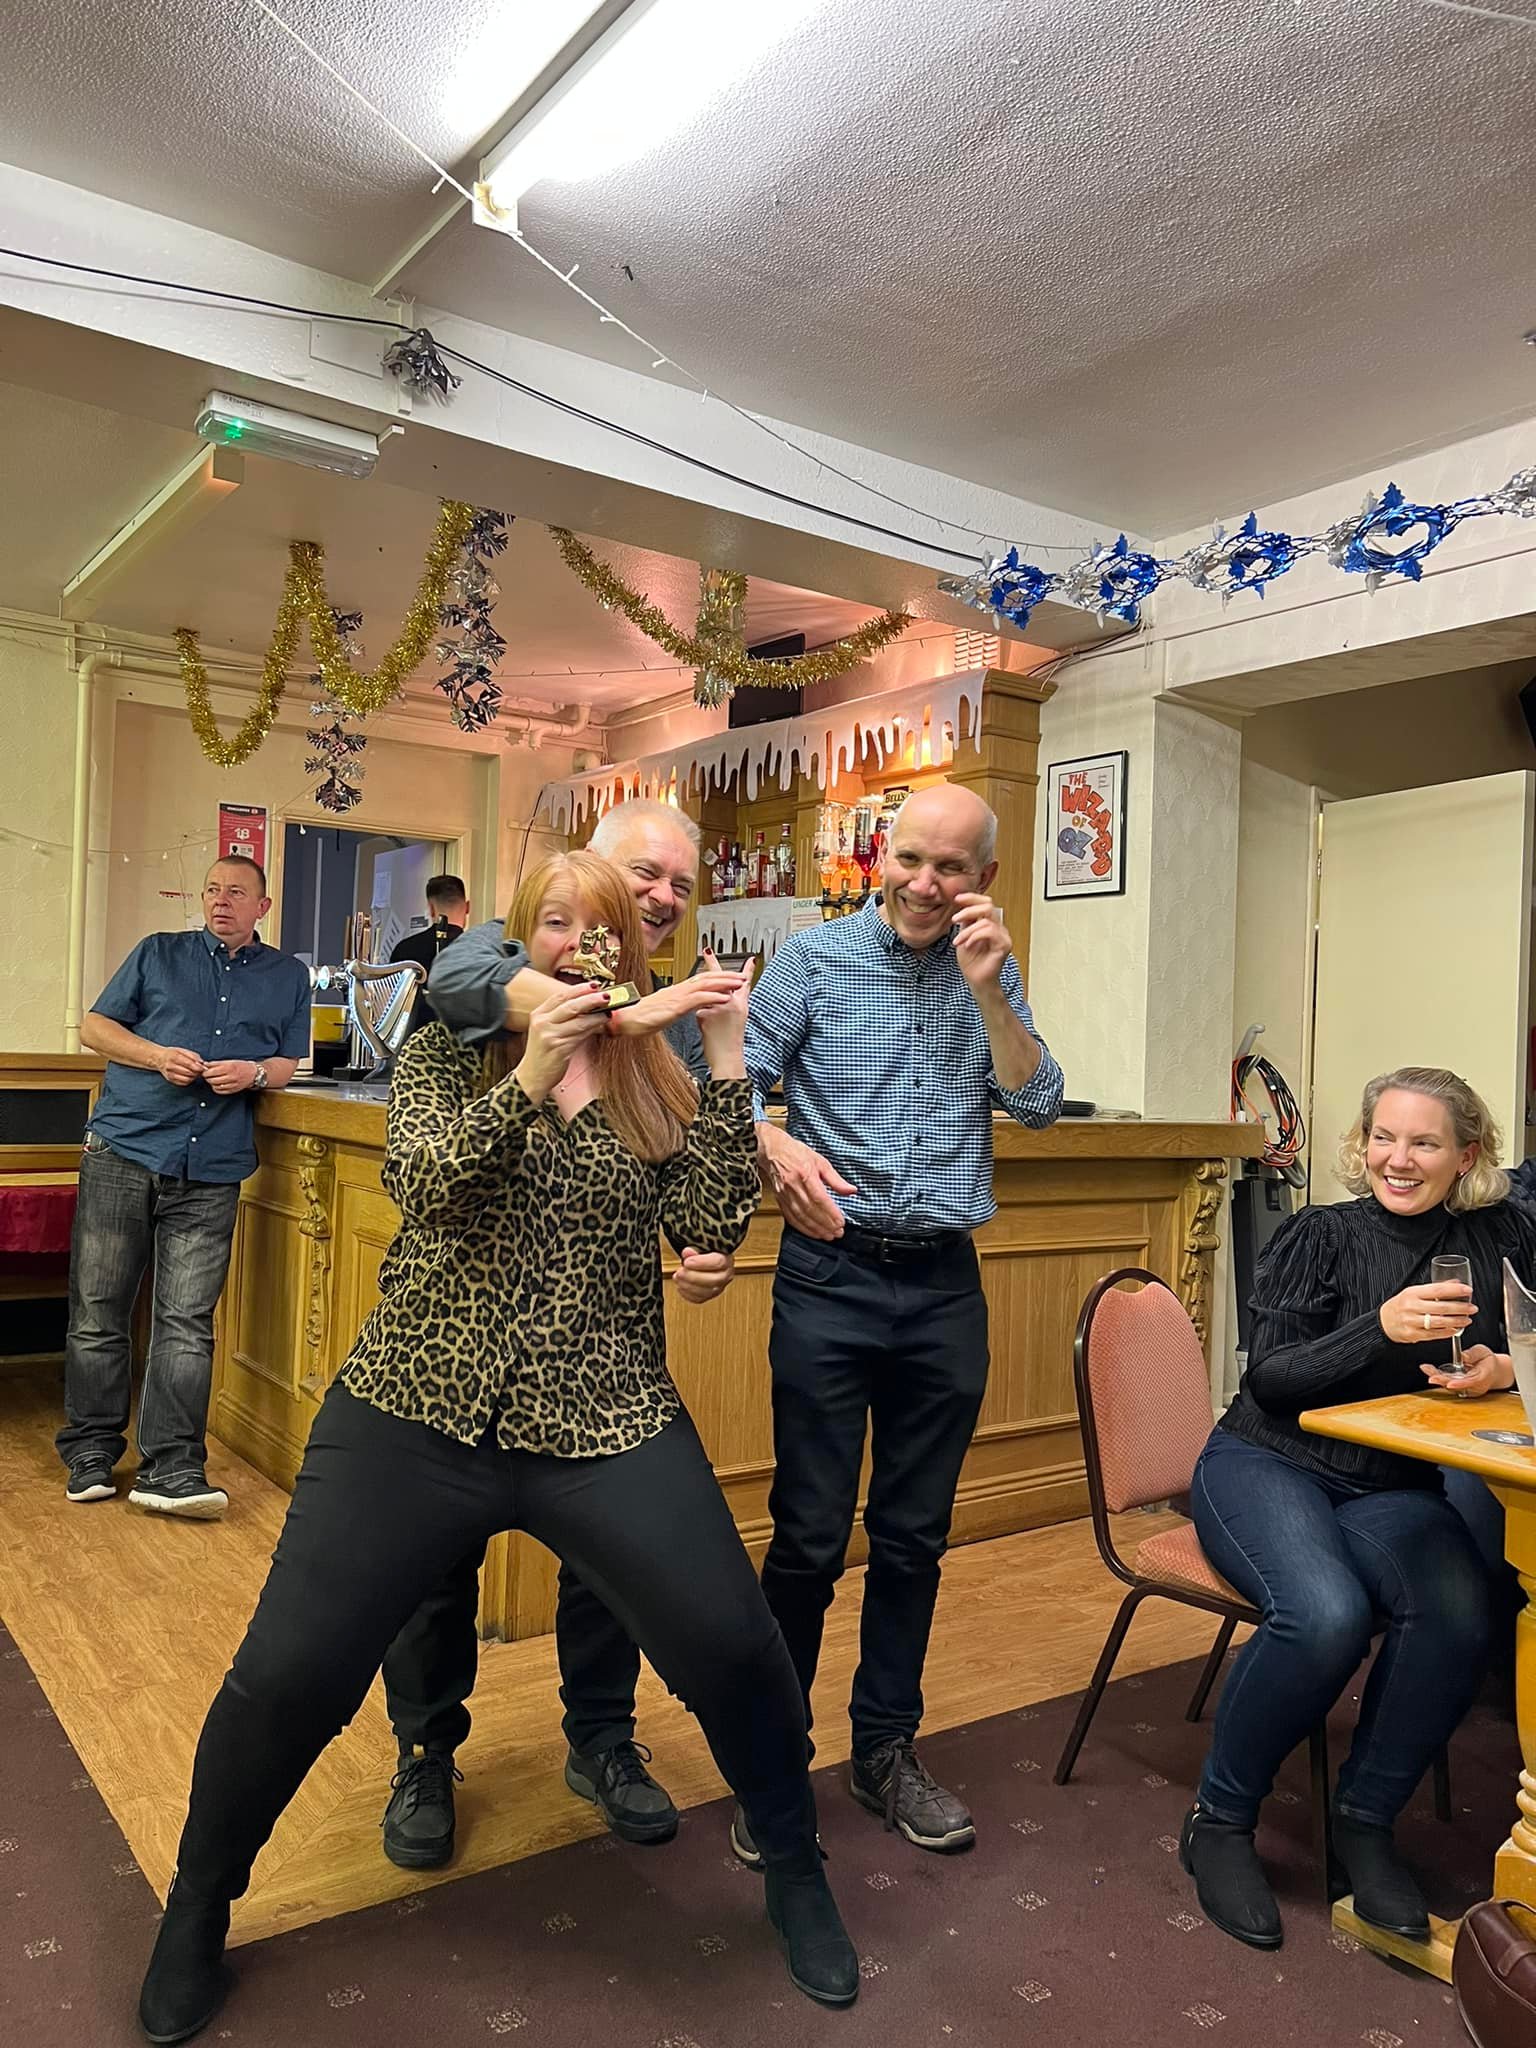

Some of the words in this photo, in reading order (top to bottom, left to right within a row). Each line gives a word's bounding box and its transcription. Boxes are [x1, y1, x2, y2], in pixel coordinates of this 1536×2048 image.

[1068, 772, 1088, 785] THE
[1071, 815, 1088, 829] OF
[234, 827, 251, 841] 18
[1061, 784, 1112, 877] WIZARD
[1058, 826, 1094, 860] OZ
